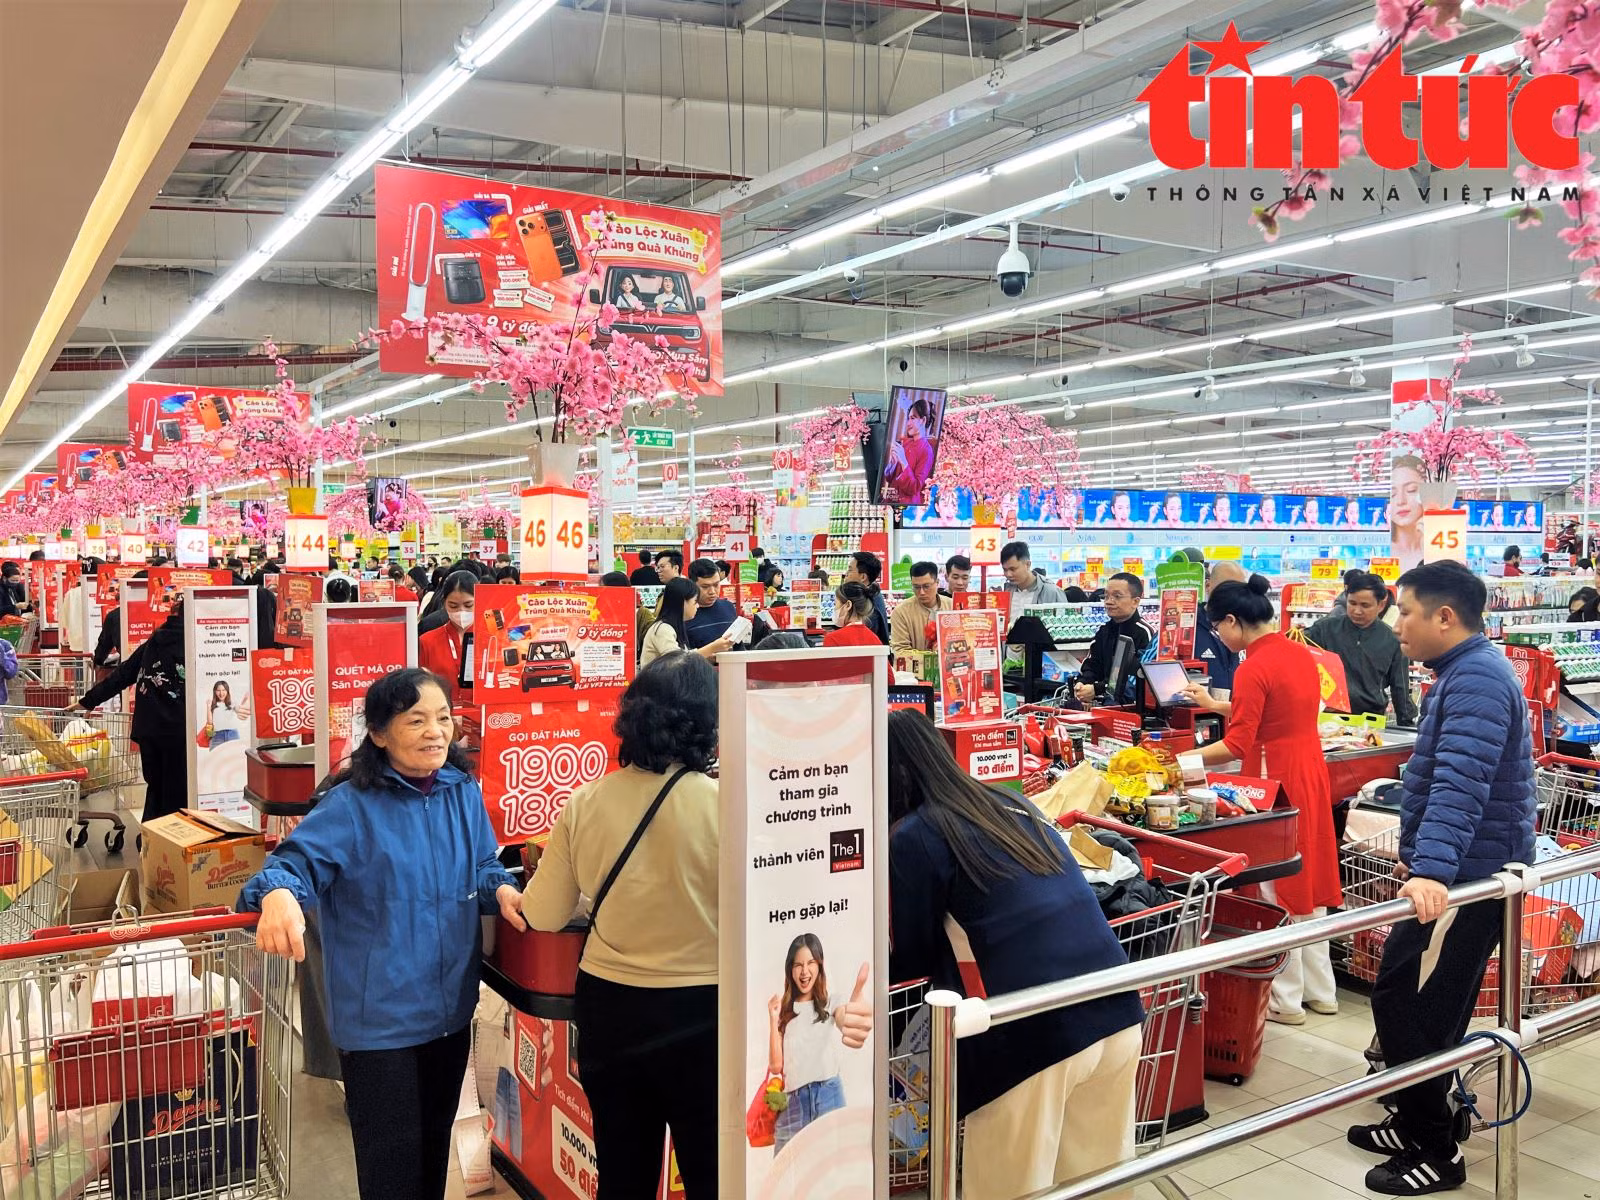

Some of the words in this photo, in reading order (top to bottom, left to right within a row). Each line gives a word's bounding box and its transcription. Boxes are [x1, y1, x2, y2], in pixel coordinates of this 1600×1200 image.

[635, 226, 657, 239] Lộc
[661, 230, 690, 245] Xuân
[637, 241, 661, 253] Quà
[664, 245, 699, 263] Khủng
[518, 320, 537, 332] đồ
[525, 518, 546, 548] 46
[556, 518, 583, 549] 46
[1431, 530, 1459, 549] 45
[128, 544, 143, 554] 40
[187, 541, 204, 552] 42
[302, 534, 324, 551] 44
[404, 546, 414, 554] 35
[483, 546, 493, 554] 37
[731, 542, 744, 552] 41
[975, 539, 996, 552] 43
[1318, 568, 1331, 577] 79
[548, 598, 563, 607] Lộc
[565, 598, 588, 606] Xuân
[525, 608, 548, 616] Trúng
[566, 607, 591, 616] Khủng
[578, 627, 587, 637] 9
[588, 628, 599, 638] tỷ
[336, 664, 364, 676] QUÉT
[367, 664, 384, 674] MÃ
[332, 680, 350, 689] Săn
[353, 678, 375, 688] Dea
[268, 677, 314, 707] 190
[268, 706, 314, 734] 188
[508, 732, 528, 742] GỌI
[531, 729, 550, 741] ĐẶT
[553, 726, 580, 739] HÀNG
[972, 734, 986, 742] Tích
[987, 729, 1004, 740] điểm
[977, 754, 996, 762] 10.000
[500, 741, 608, 792] 1900
[769, 766, 799, 781] Cảm
[803, 766, 821, 778] ơn
[825, 762, 848, 778] bạn
[978, 765, 989, 775] 50
[992, 760, 1014, 773] điểm
[780, 787, 814, 801] tham
[818, 784, 838, 799] gia
[499, 788, 572, 836] 188
[766, 808, 816, 824] chương
[820, 804, 852, 817] trình
[754, 854, 792, 869] thành
[796, 848, 824, 864] viên
[835, 861, 860, 870] Vietnam
[769, 908, 797, 924] Hẹn
[800, 902, 825, 921] gặp
[829, 898, 849, 915] lại!
[554, 1083, 566, 1101] Tích
[566, 1094, 580, 1116] điểm
[581, 1106, 590, 1124] khi
[561, 1122, 587, 1158] 10.000
[589, 1150, 597, 1169] vn
[560, 1147, 576, 1182] 50
[578, 1168, 599, 1200] điể
